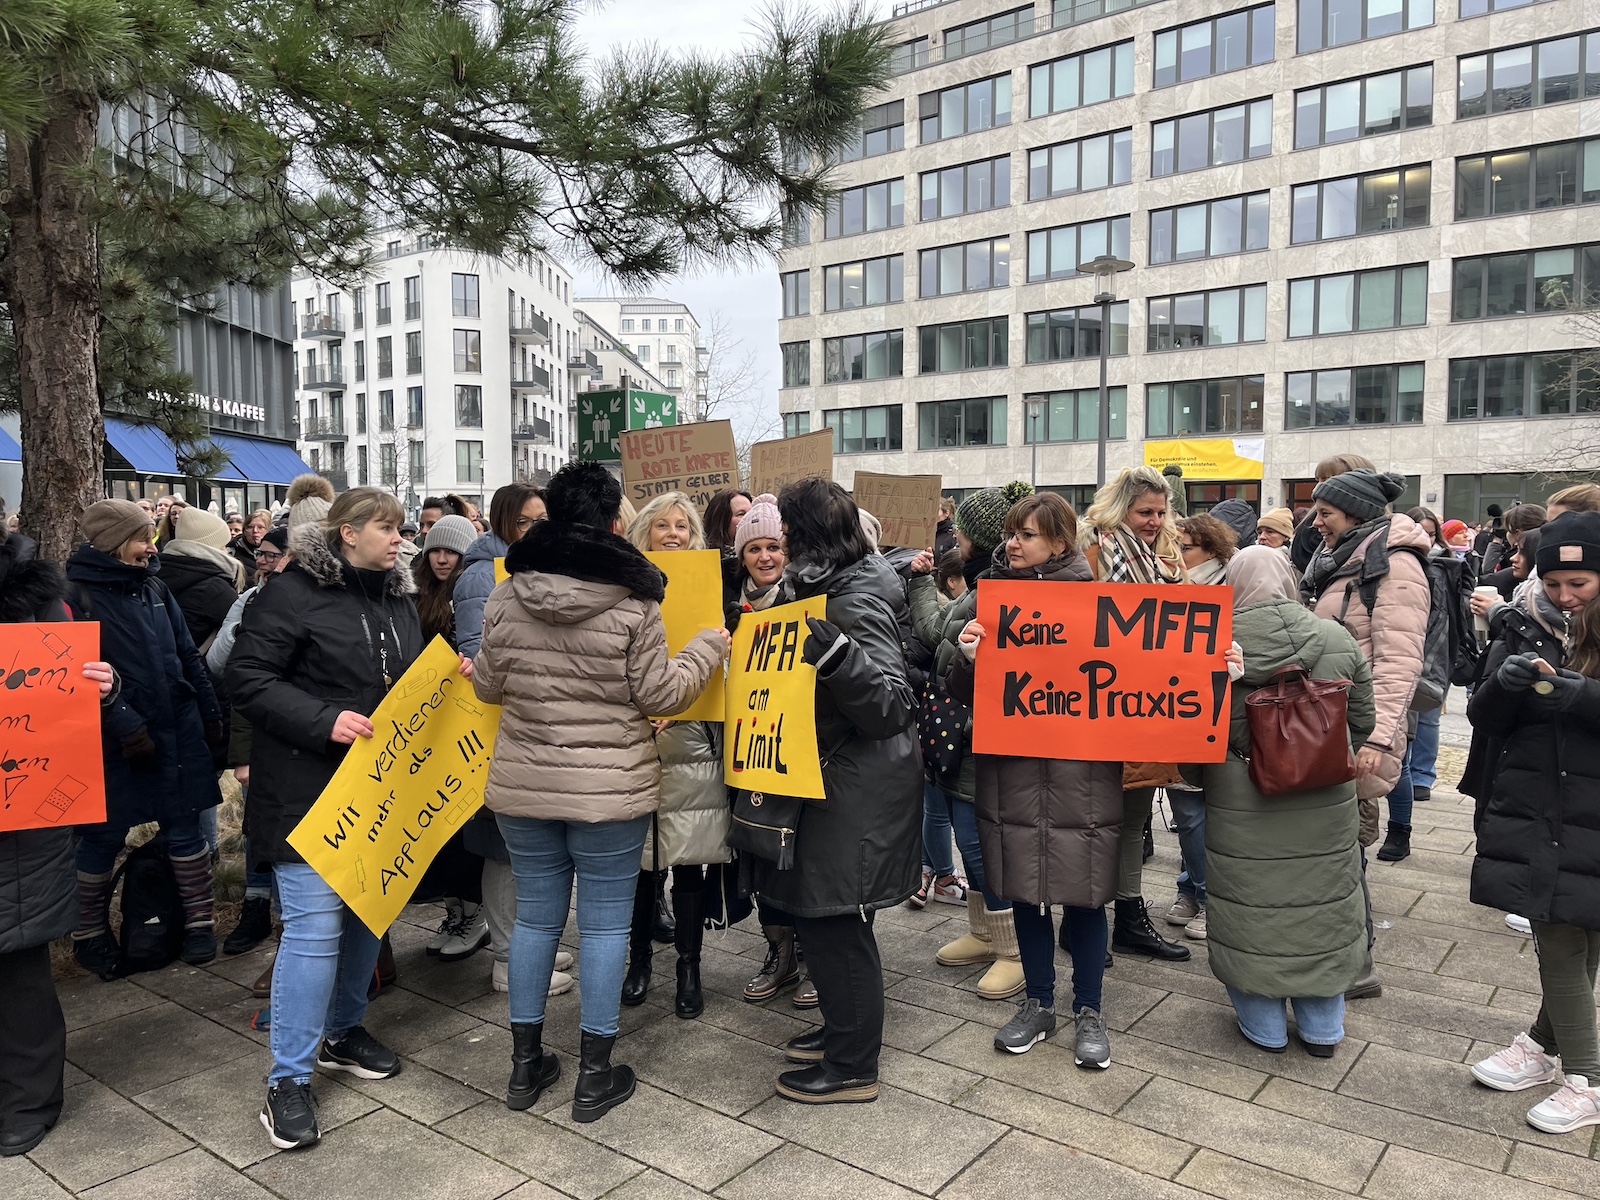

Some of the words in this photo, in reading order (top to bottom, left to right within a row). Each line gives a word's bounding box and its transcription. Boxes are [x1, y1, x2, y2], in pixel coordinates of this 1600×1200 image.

[222, 399, 265, 421] KAFFEE
[626, 430, 693, 460] HEUTE
[760, 437, 819, 473] MEHR
[641, 457, 681, 479] ROTE
[685, 451, 730, 472] KARTE
[633, 479, 681, 500] STATT
[685, 472, 730, 488] GELBER
[856, 479, 903, 514] MFA
[907, 483, 939, 514] AM
[997, 604, 1067, 649] Keine
[1093, 595, 1221, 655] MFA
[748, 687, 770, 711] am
[1003, 671, 1082, 718] Keine
[1079, 660, 1230, 743] Praxis!
[732, 713, 787, 775] Limit
[367, 789, 398, 843] mehr
[409, 746, 434, 775] als
